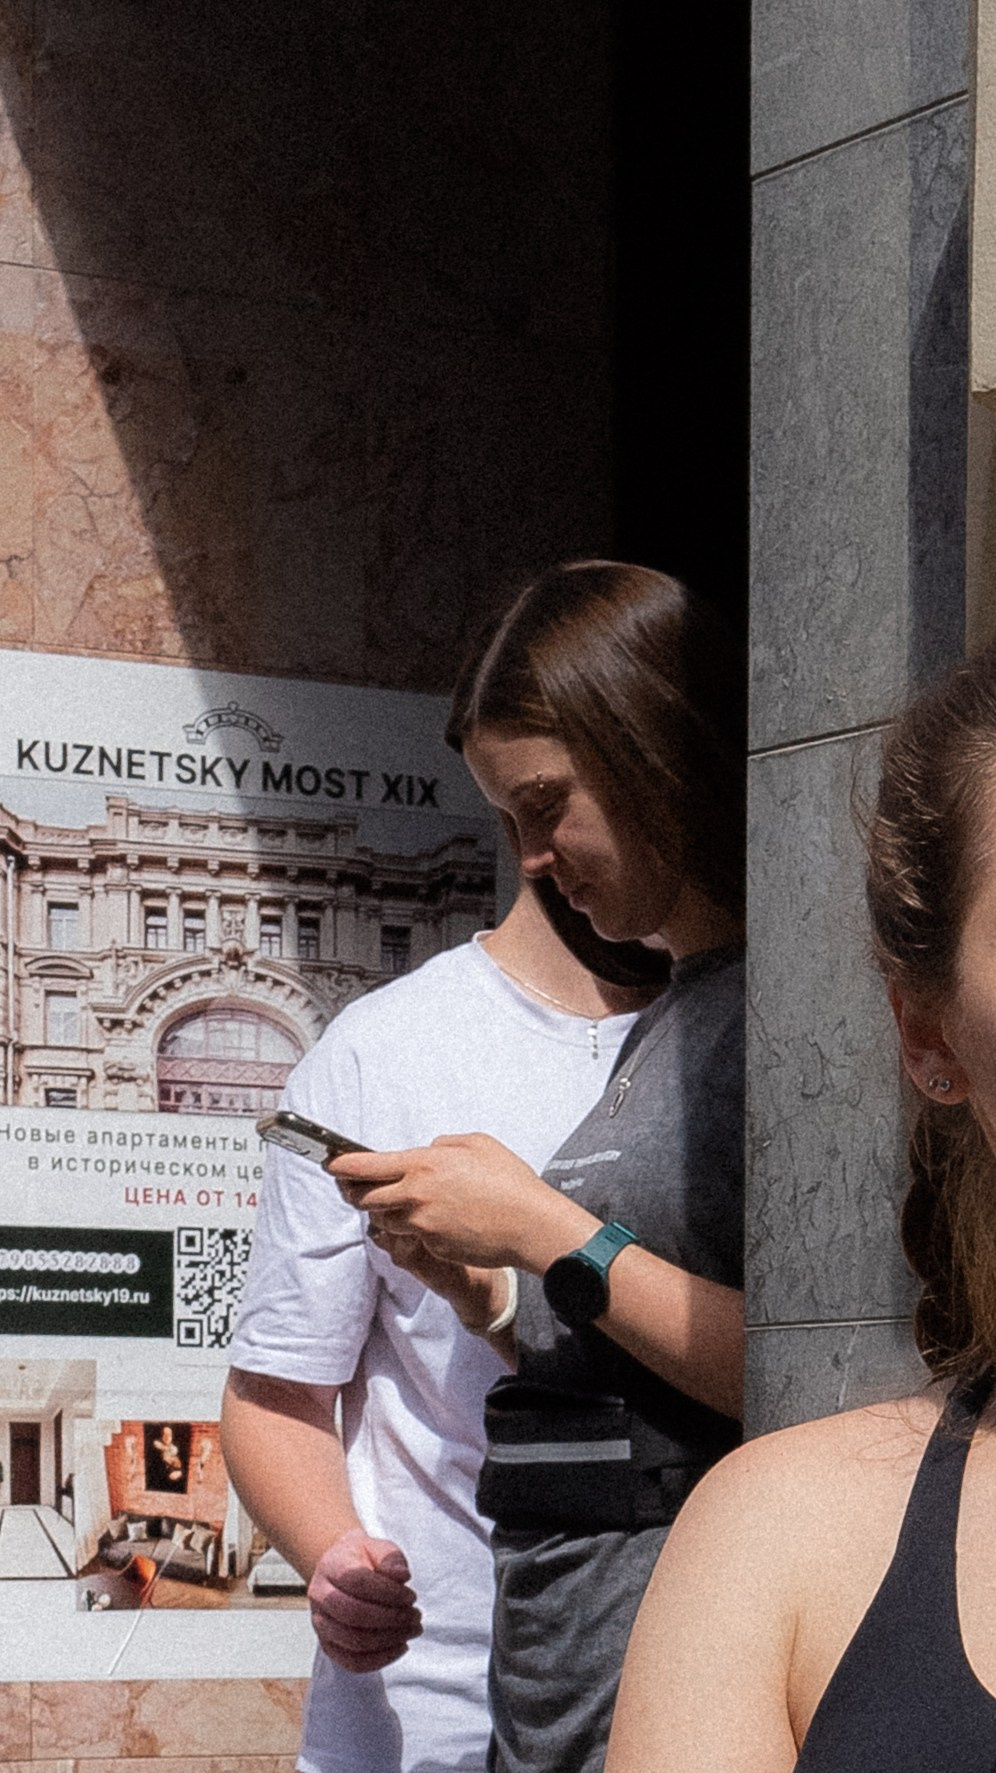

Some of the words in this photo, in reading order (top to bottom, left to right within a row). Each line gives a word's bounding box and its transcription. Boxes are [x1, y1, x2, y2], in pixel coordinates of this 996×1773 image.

[16, 738, 251, 792] KUZNETSKY
[261, 761, 370, 803] MOST
[380, 773, 441, 808] XIX
[87, 1129, 248, 1152] апартаменты
[28, 1156, 39, 1171] в
[51, 1155, 226, 1179] историческом
[124, 1187, 187, 1206] ЦЕНА
[196, 1190, 225, 1207] ОТ
